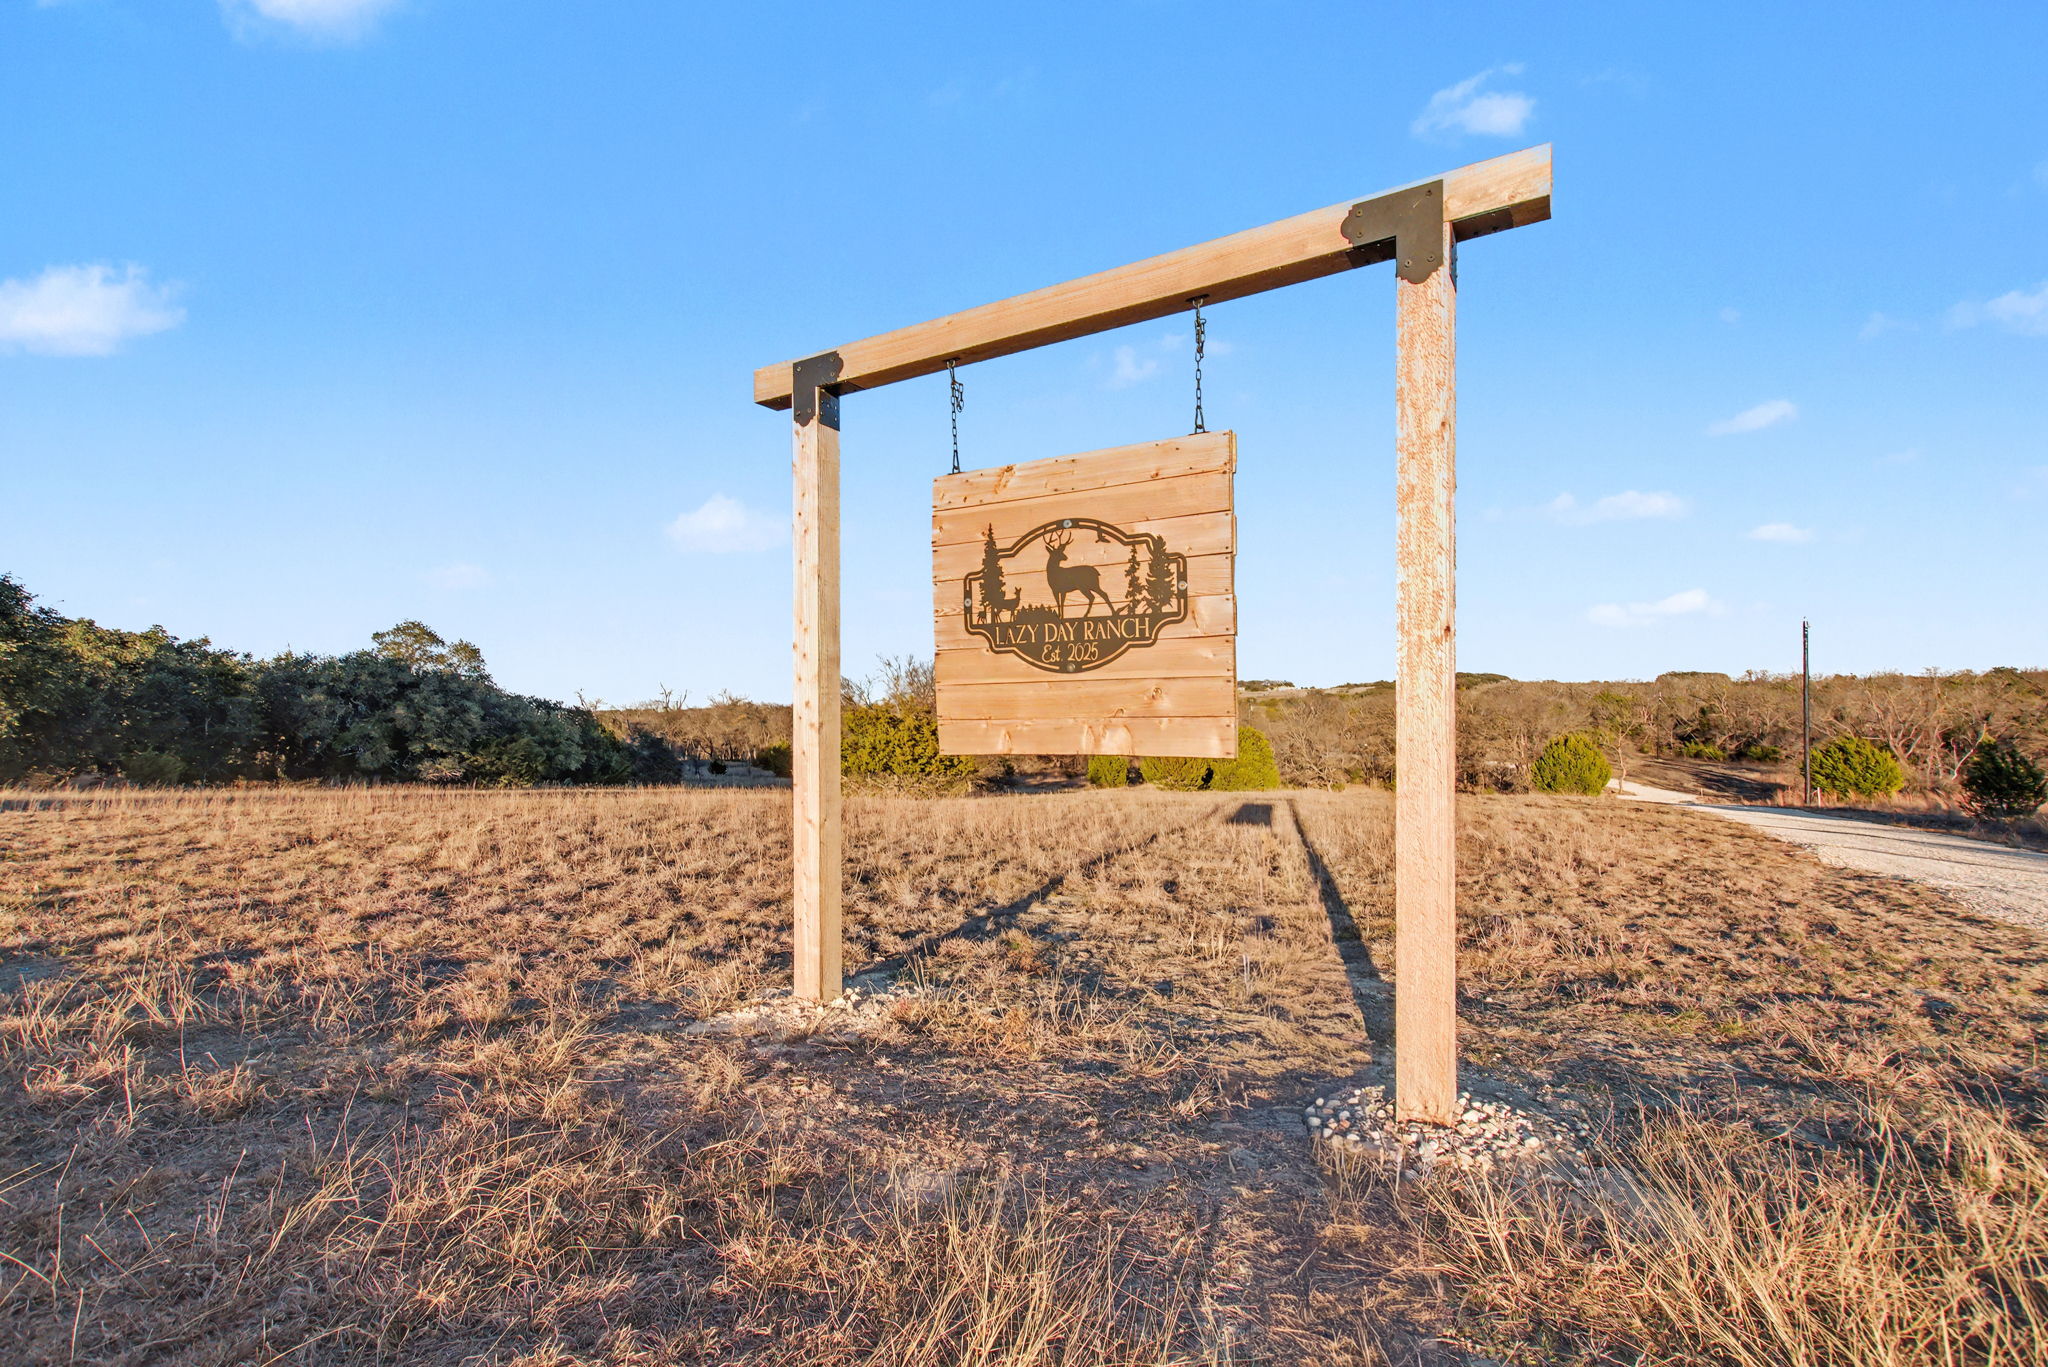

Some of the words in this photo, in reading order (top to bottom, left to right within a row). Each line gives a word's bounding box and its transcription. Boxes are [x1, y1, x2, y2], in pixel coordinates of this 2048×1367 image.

[995, 624, 1038, 645] LAZY
[1044, 622, 1079, 642] DAY
[1083, 617, 1151, 640] RANCH
[1041, 644, 1064, 663] Est.
[1067, 642, 1099, 662] 2025
